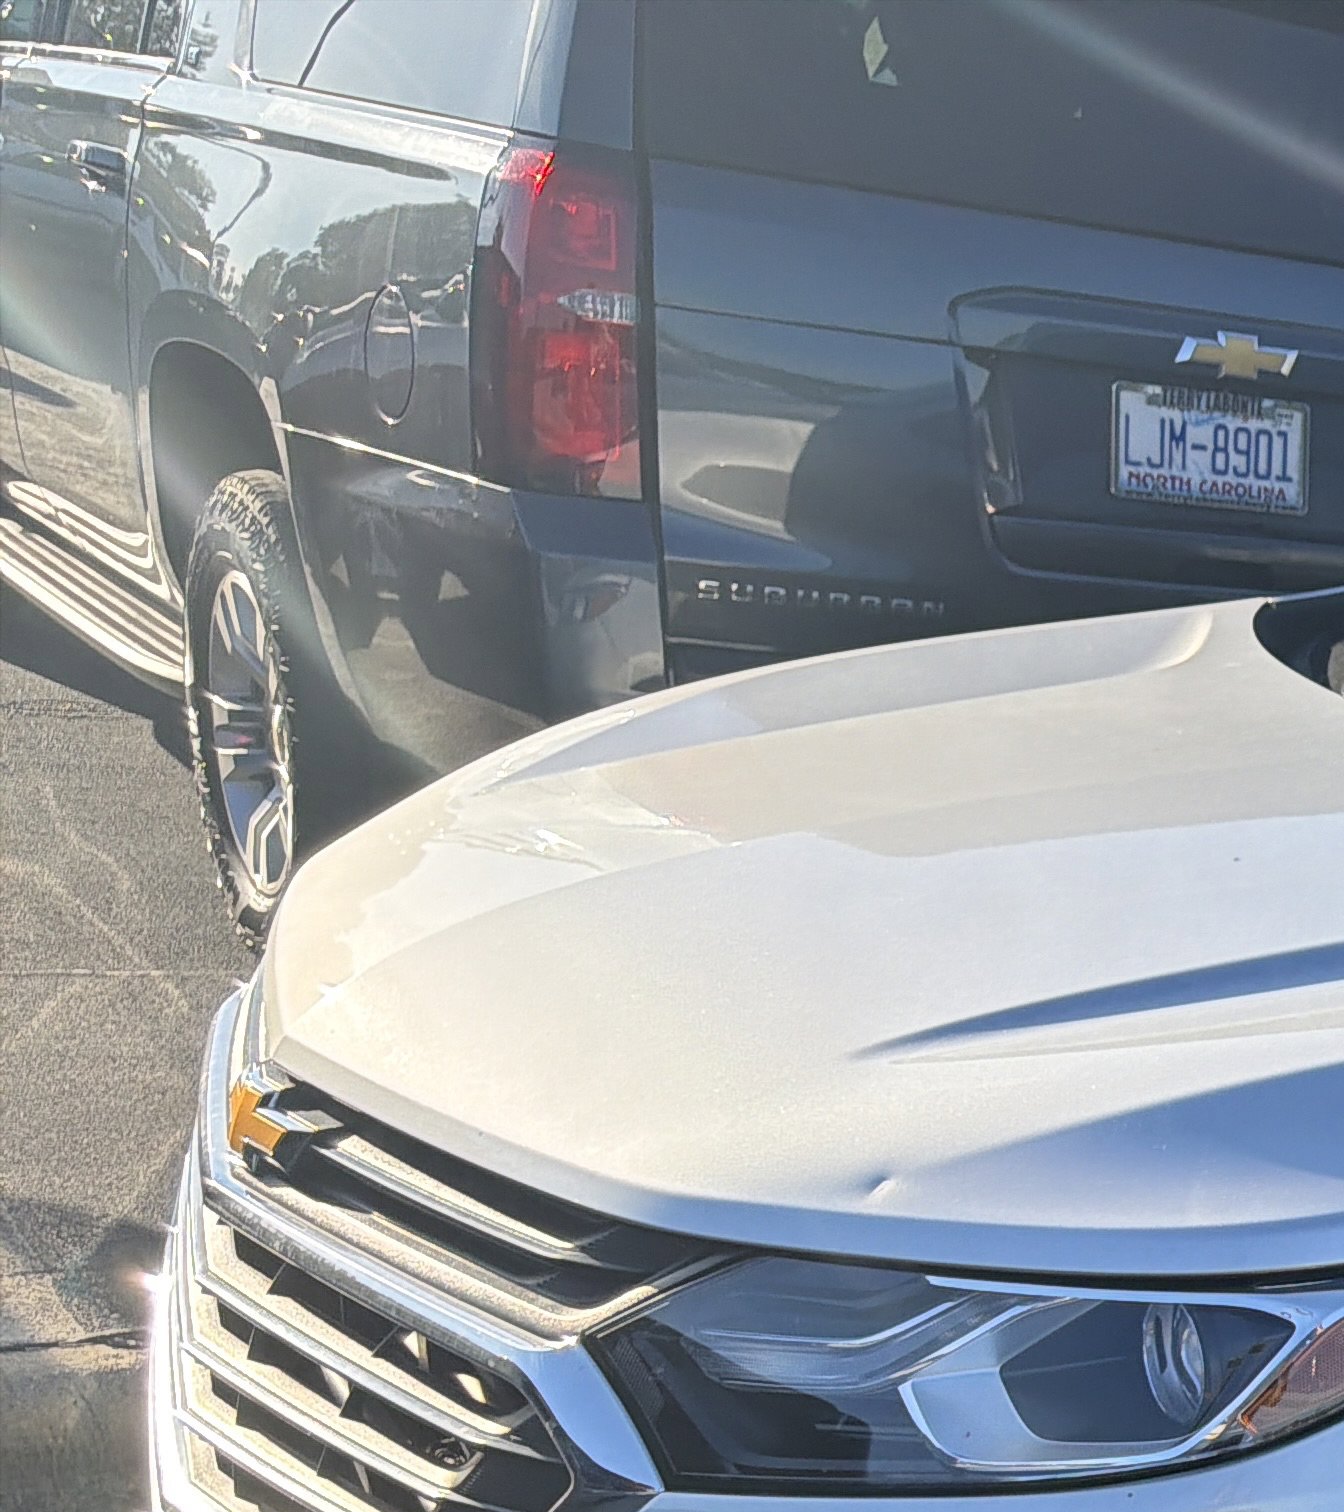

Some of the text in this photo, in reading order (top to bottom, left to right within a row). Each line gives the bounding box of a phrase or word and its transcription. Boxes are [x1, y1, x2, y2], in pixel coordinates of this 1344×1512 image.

[1124, 412, 1293, 483] LJM-8901
[1127, 471, 1192, 492] NORTH
[1199, 479, 1287, 502] CAROLINA
[697, 578, 945, 616] SUBURBAN
